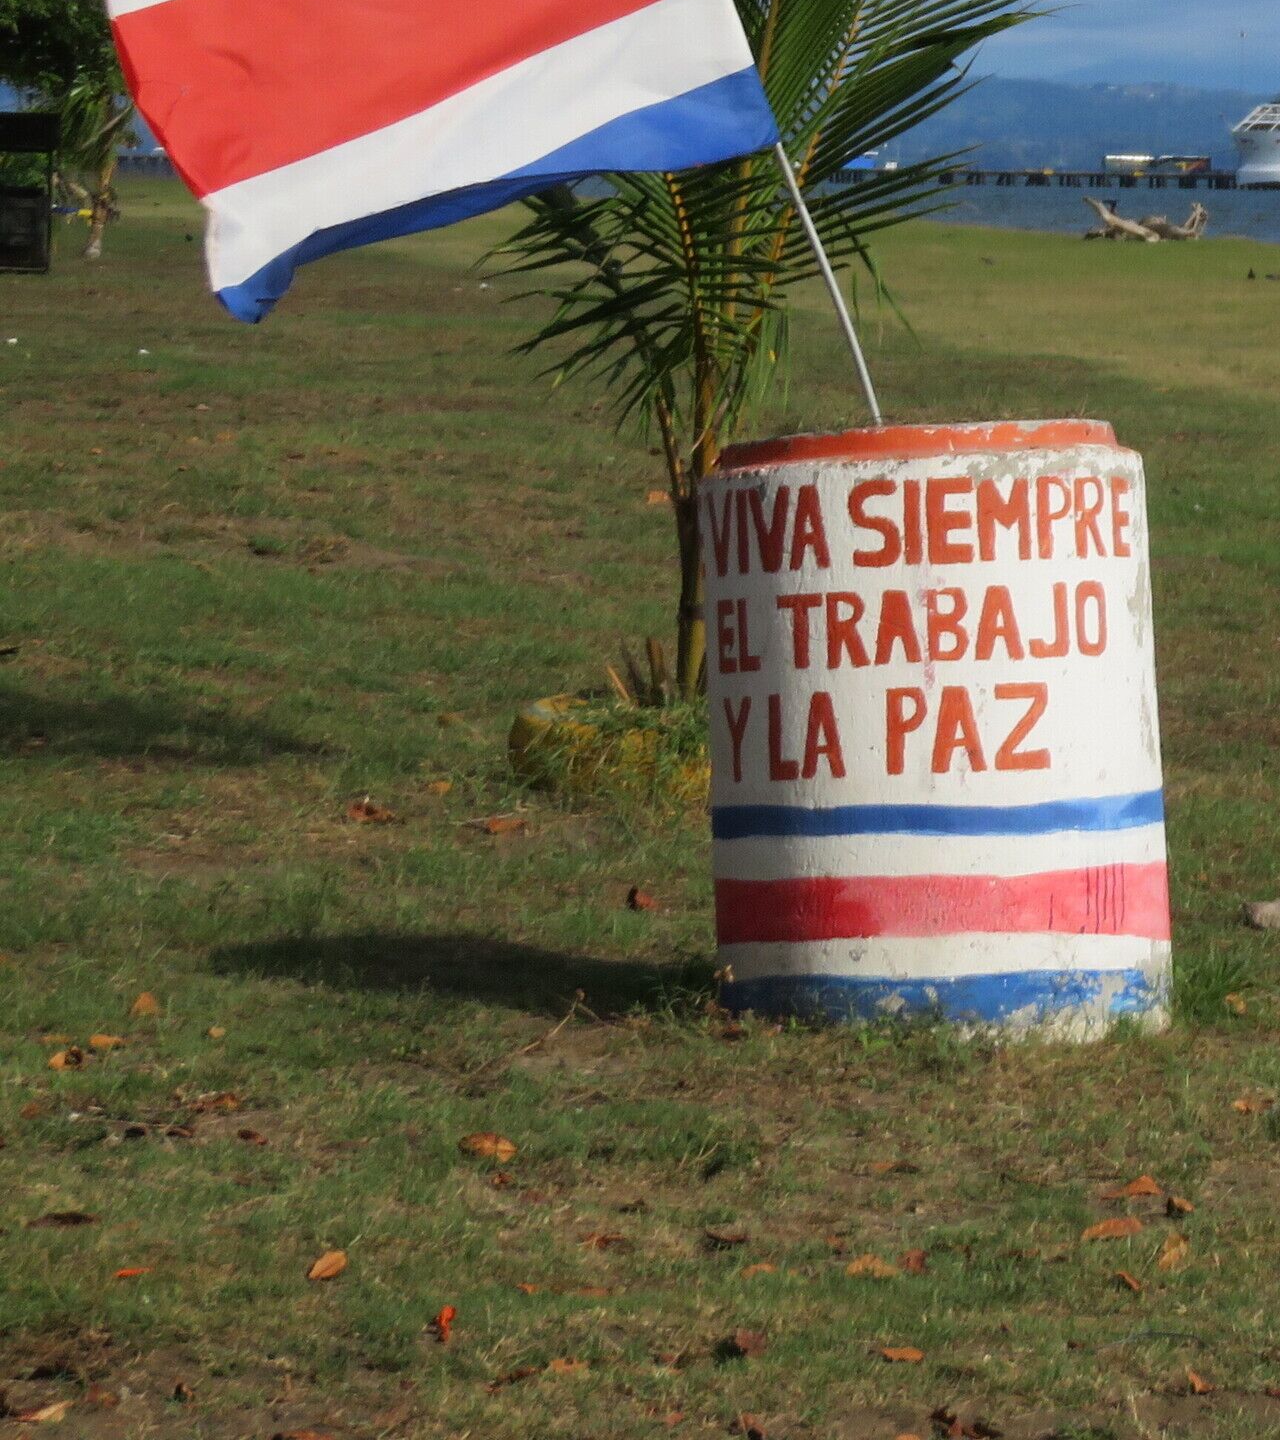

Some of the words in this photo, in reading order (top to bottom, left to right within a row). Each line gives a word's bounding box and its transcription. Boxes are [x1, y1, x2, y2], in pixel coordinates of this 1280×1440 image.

[705, 483, 830, 577] VIVA
[847, 476, 1131, 568] SIEMPRE
[717, 597, 760, 674] EL
[776, 580, 1108, 670] TRABAJO
[885, 681, 1051, 775] PAZ
